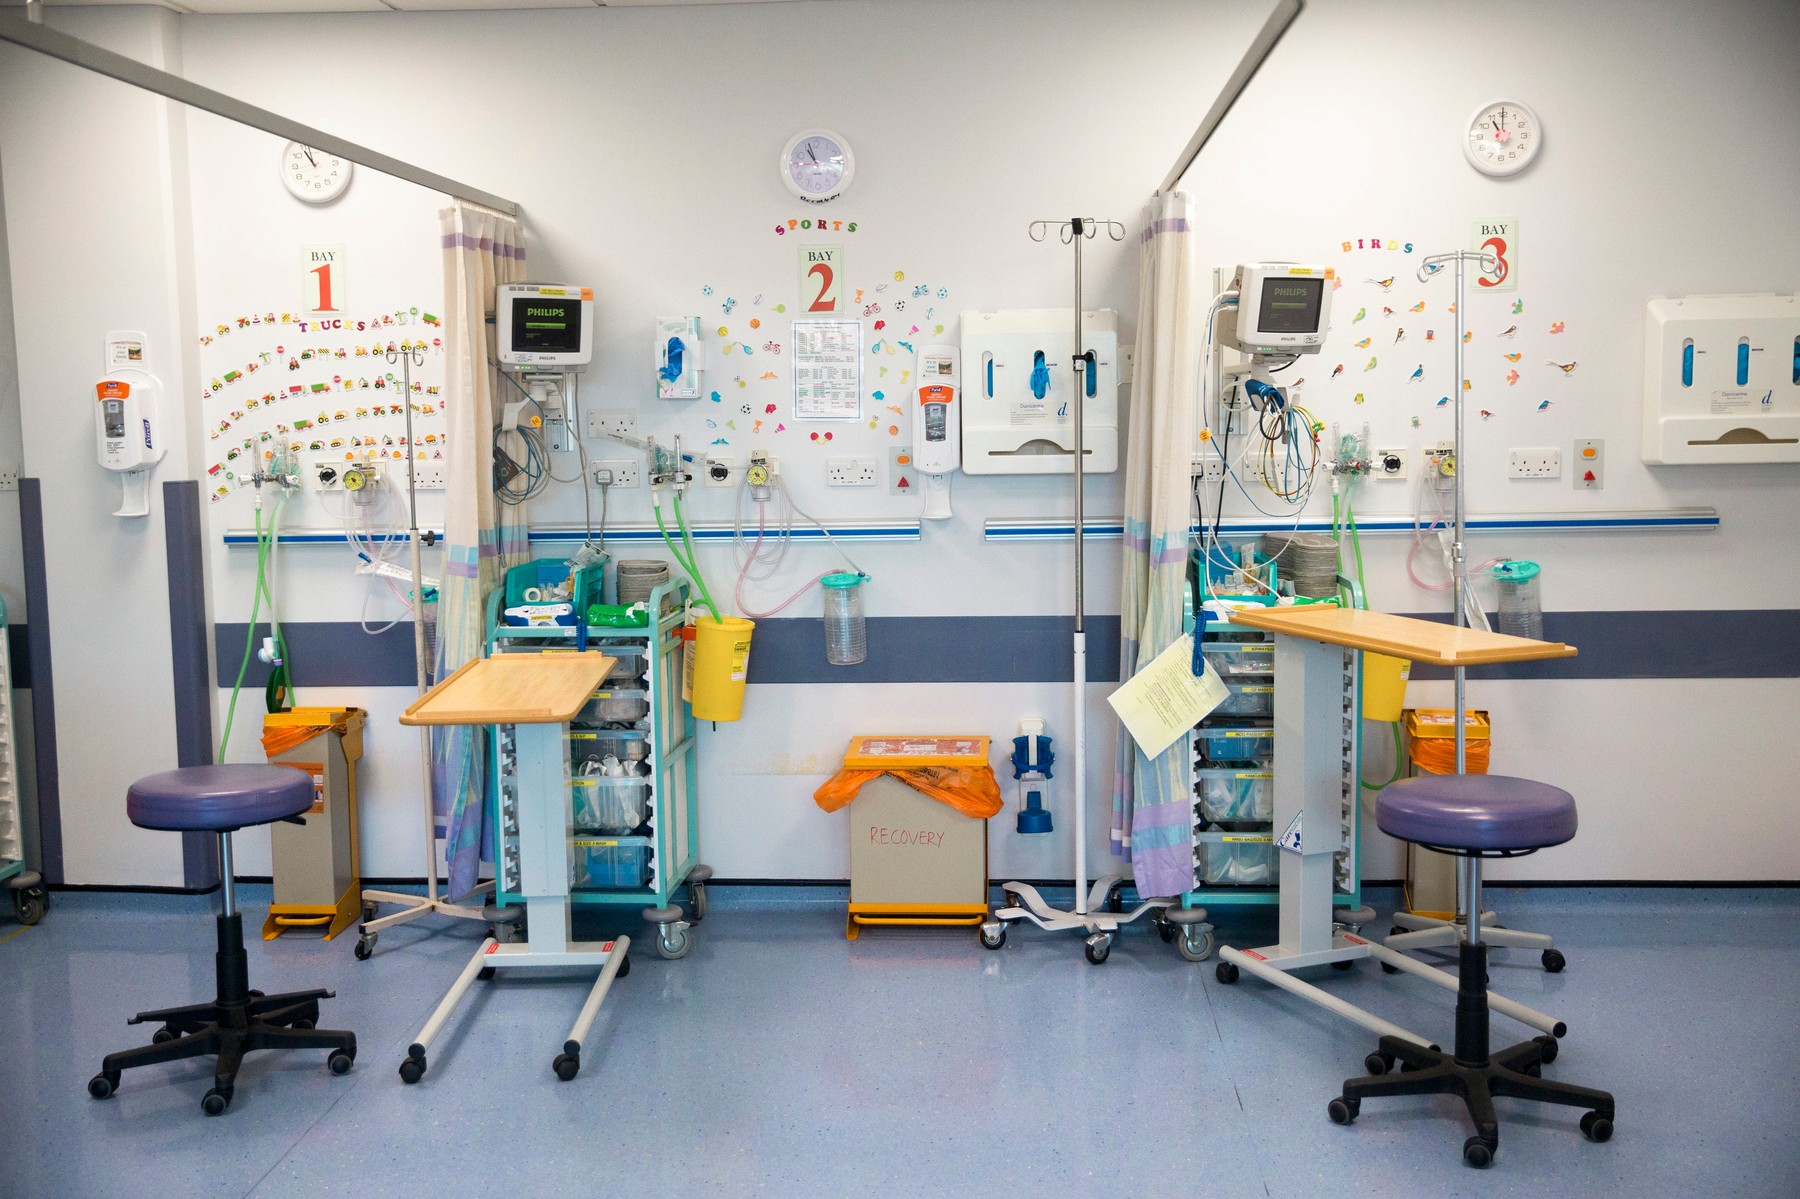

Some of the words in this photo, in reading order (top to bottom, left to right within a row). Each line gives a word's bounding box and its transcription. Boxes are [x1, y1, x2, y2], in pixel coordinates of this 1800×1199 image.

[1479, 122, 1490, 130] 10
[293, 152, 303, 160] 10
[1508, 151, 1516, 159] 5
[331, 159, 339, 167] 3
[324, 178, 331, 186] 5
[775, 219, 858, 235] SPORTS
[1481, 224, 1508, 235] BAY
[1341, 238, 1414, 254] BIRDS
[311, 251, 336, 261] BAY
[807, 251, 834, 262] BAY
[1477, 237, 1509, 287] 3
[310, 263, 339, 312] 1
[807, 262, 836, 312] 2
[1273, 287, 1308, 297] PHILIPS
[526, 307, 565, 317] PHILIPS
[298, 319, 366, 333] TRUCKS
[870, 826, 945, 848] RECOVERY
